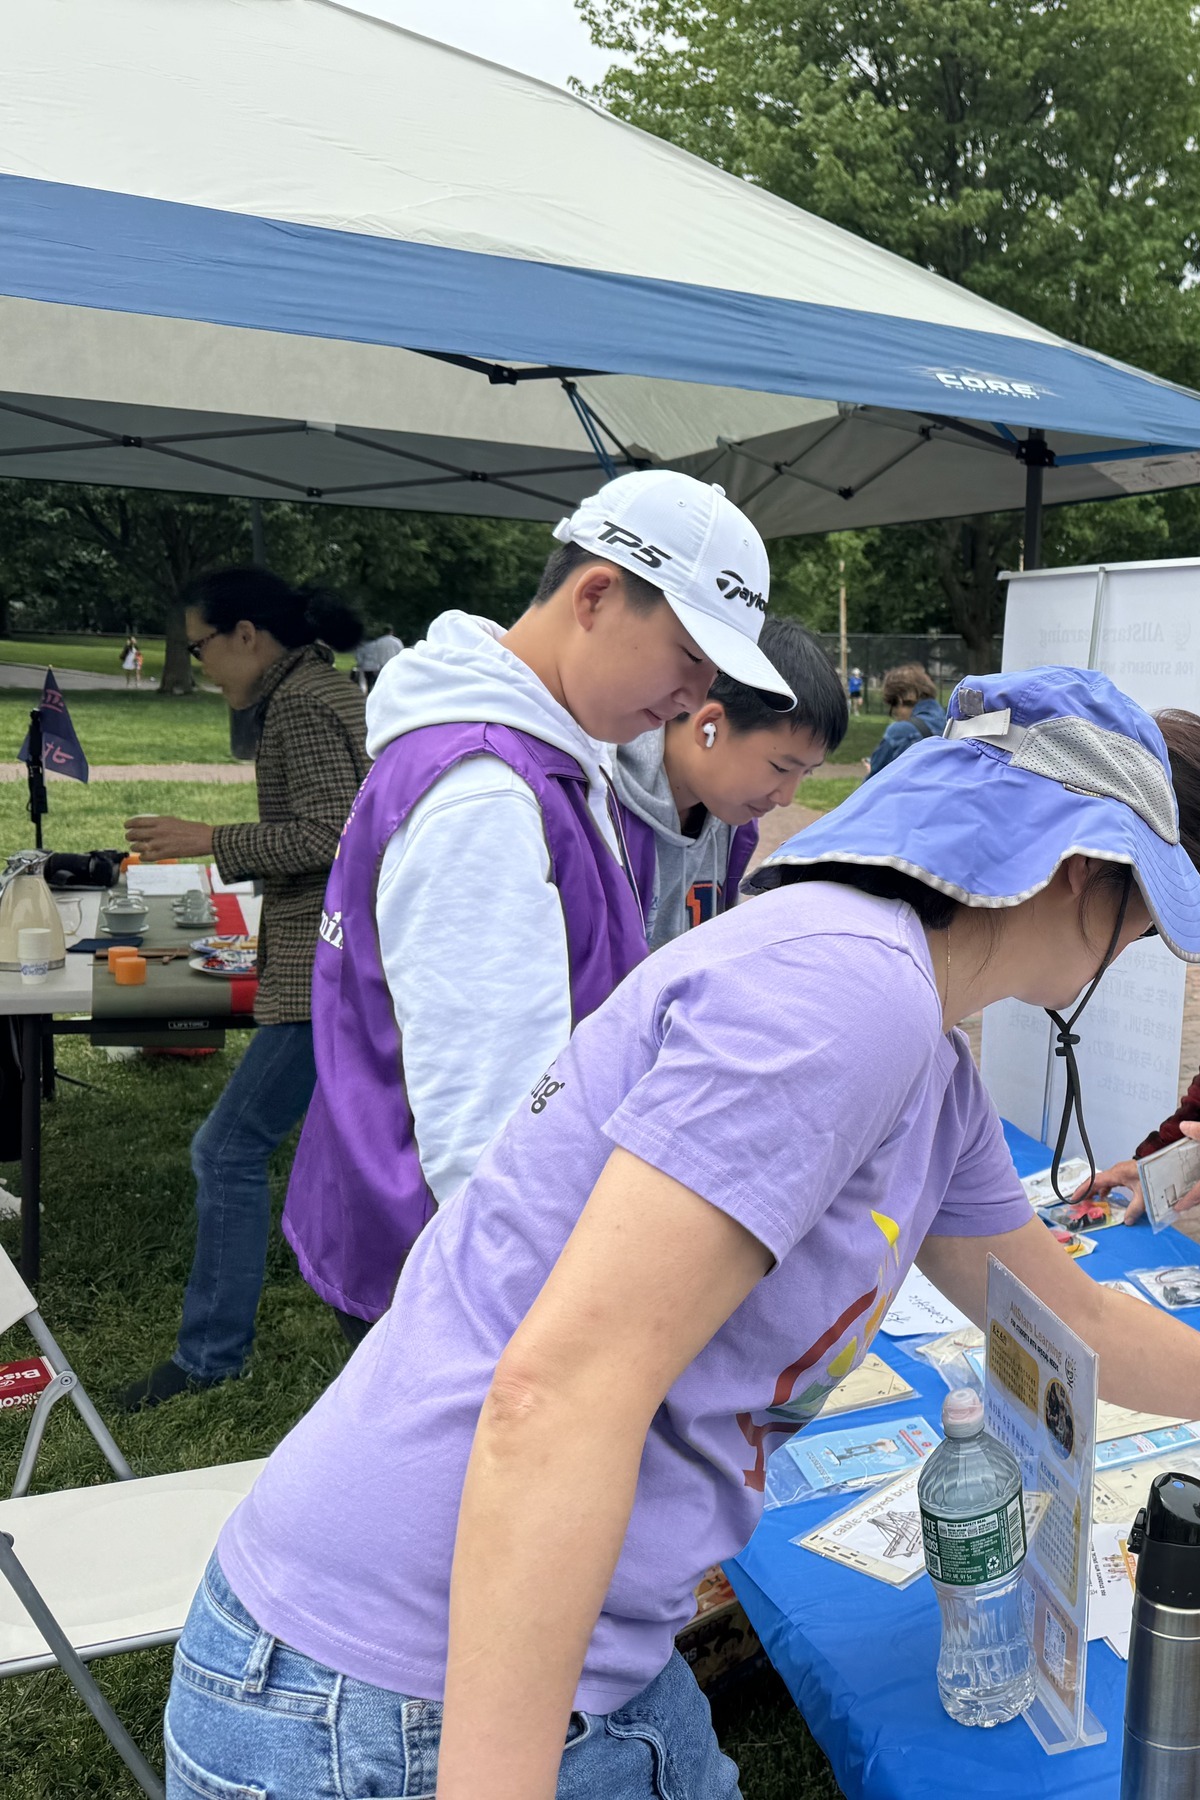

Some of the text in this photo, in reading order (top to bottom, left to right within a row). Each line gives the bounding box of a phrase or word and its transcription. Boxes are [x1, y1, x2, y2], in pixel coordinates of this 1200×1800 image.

[935, 372, 1037, 396] CORE
[597, 521, 673, 569] TP5
[832, 1496, 894, 1537] cable-stayed
